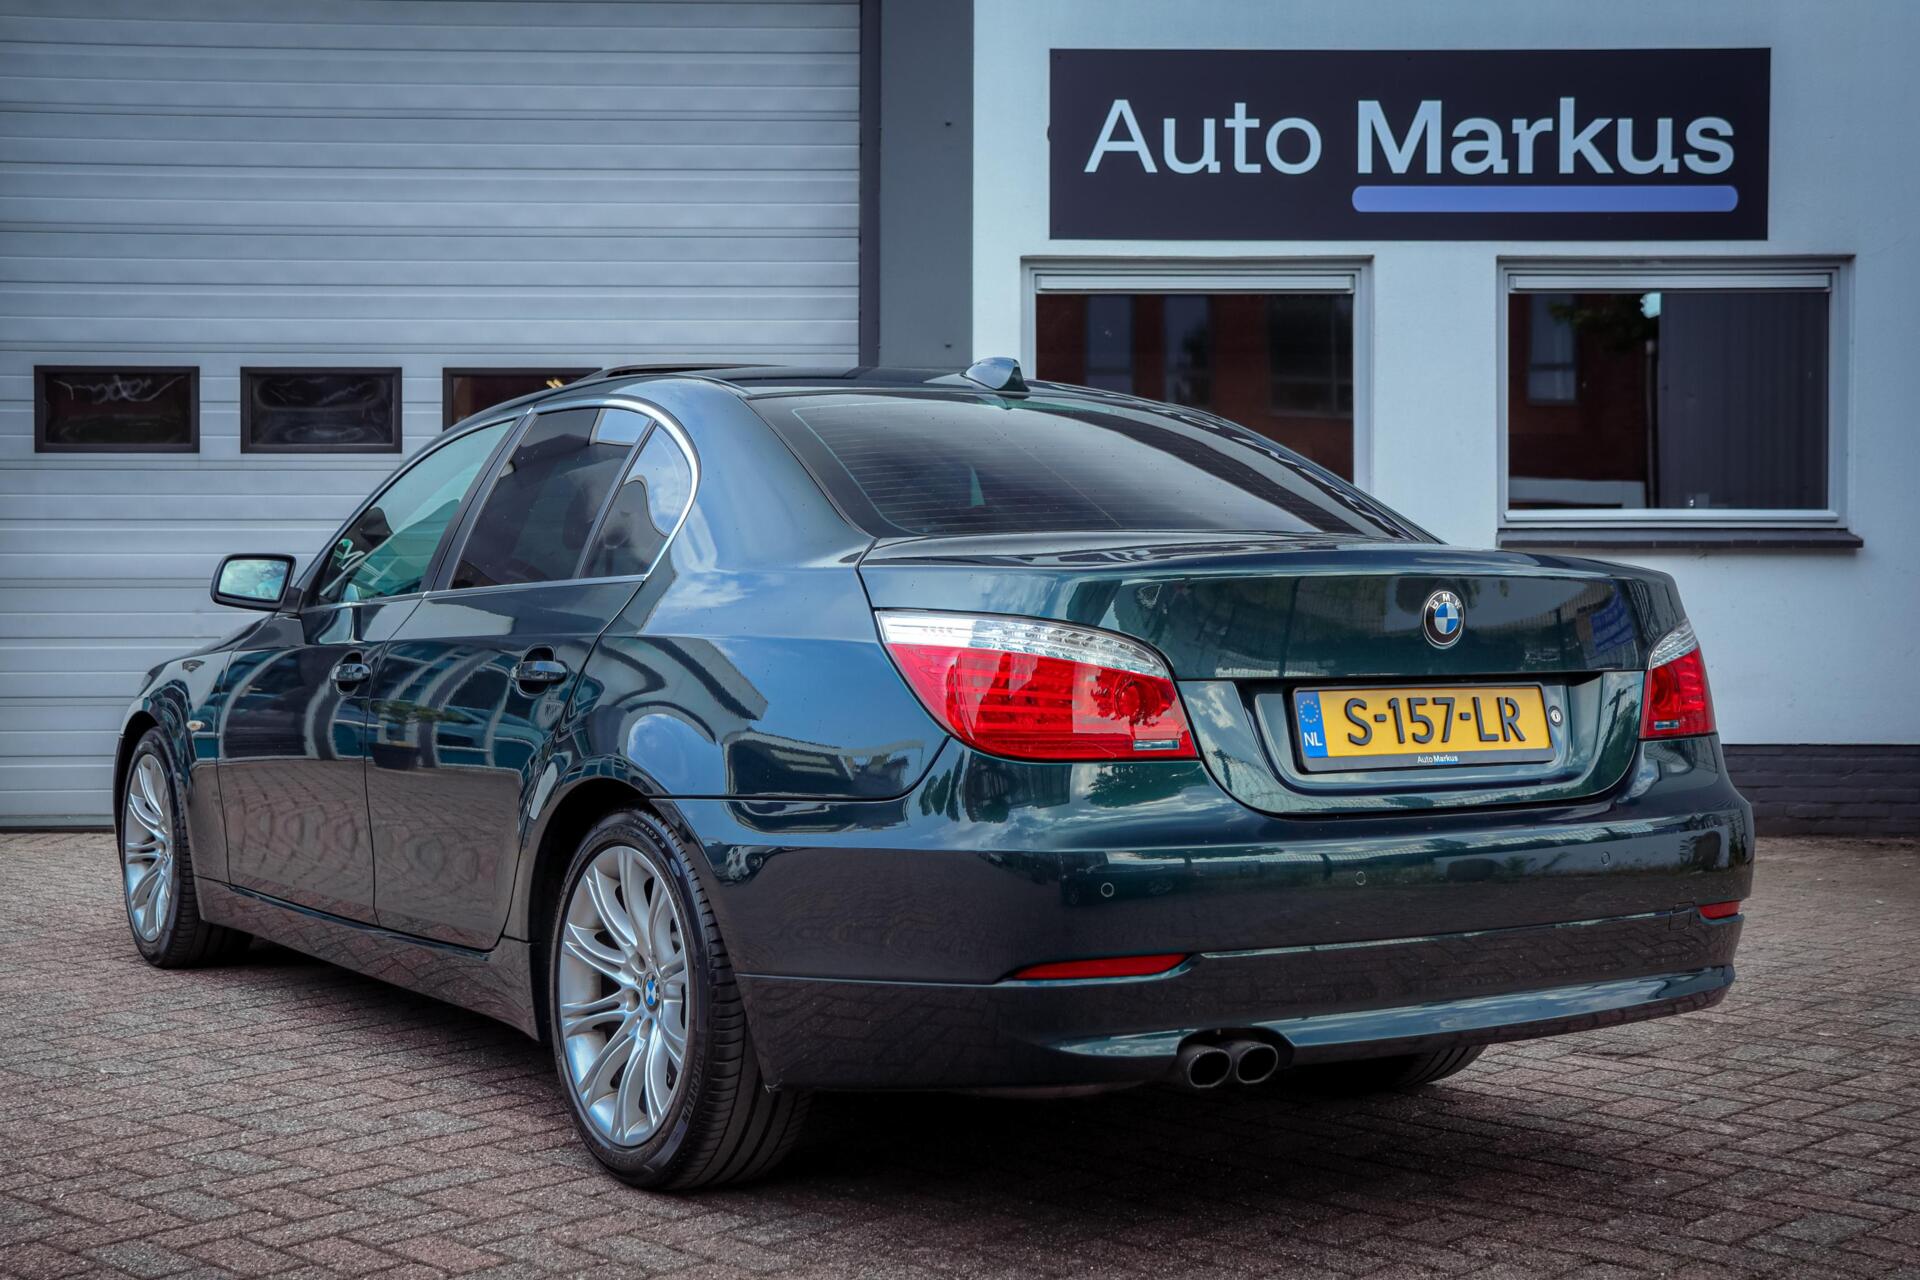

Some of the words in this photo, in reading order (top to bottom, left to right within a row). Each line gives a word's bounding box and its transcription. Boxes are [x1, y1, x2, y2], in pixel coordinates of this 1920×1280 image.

[1084, 99, 1322, 174] Auto
[1357, 97, 1735, 175] Markus
[1430, 593, 1462, 609] BMW
[1344, 697, 1526, 745] S-157-LR
[1304, 732, 1323, 747] NL
[1417, 755, 1433, 763] Auto
[1433, 754, 1458, 763] Markus
